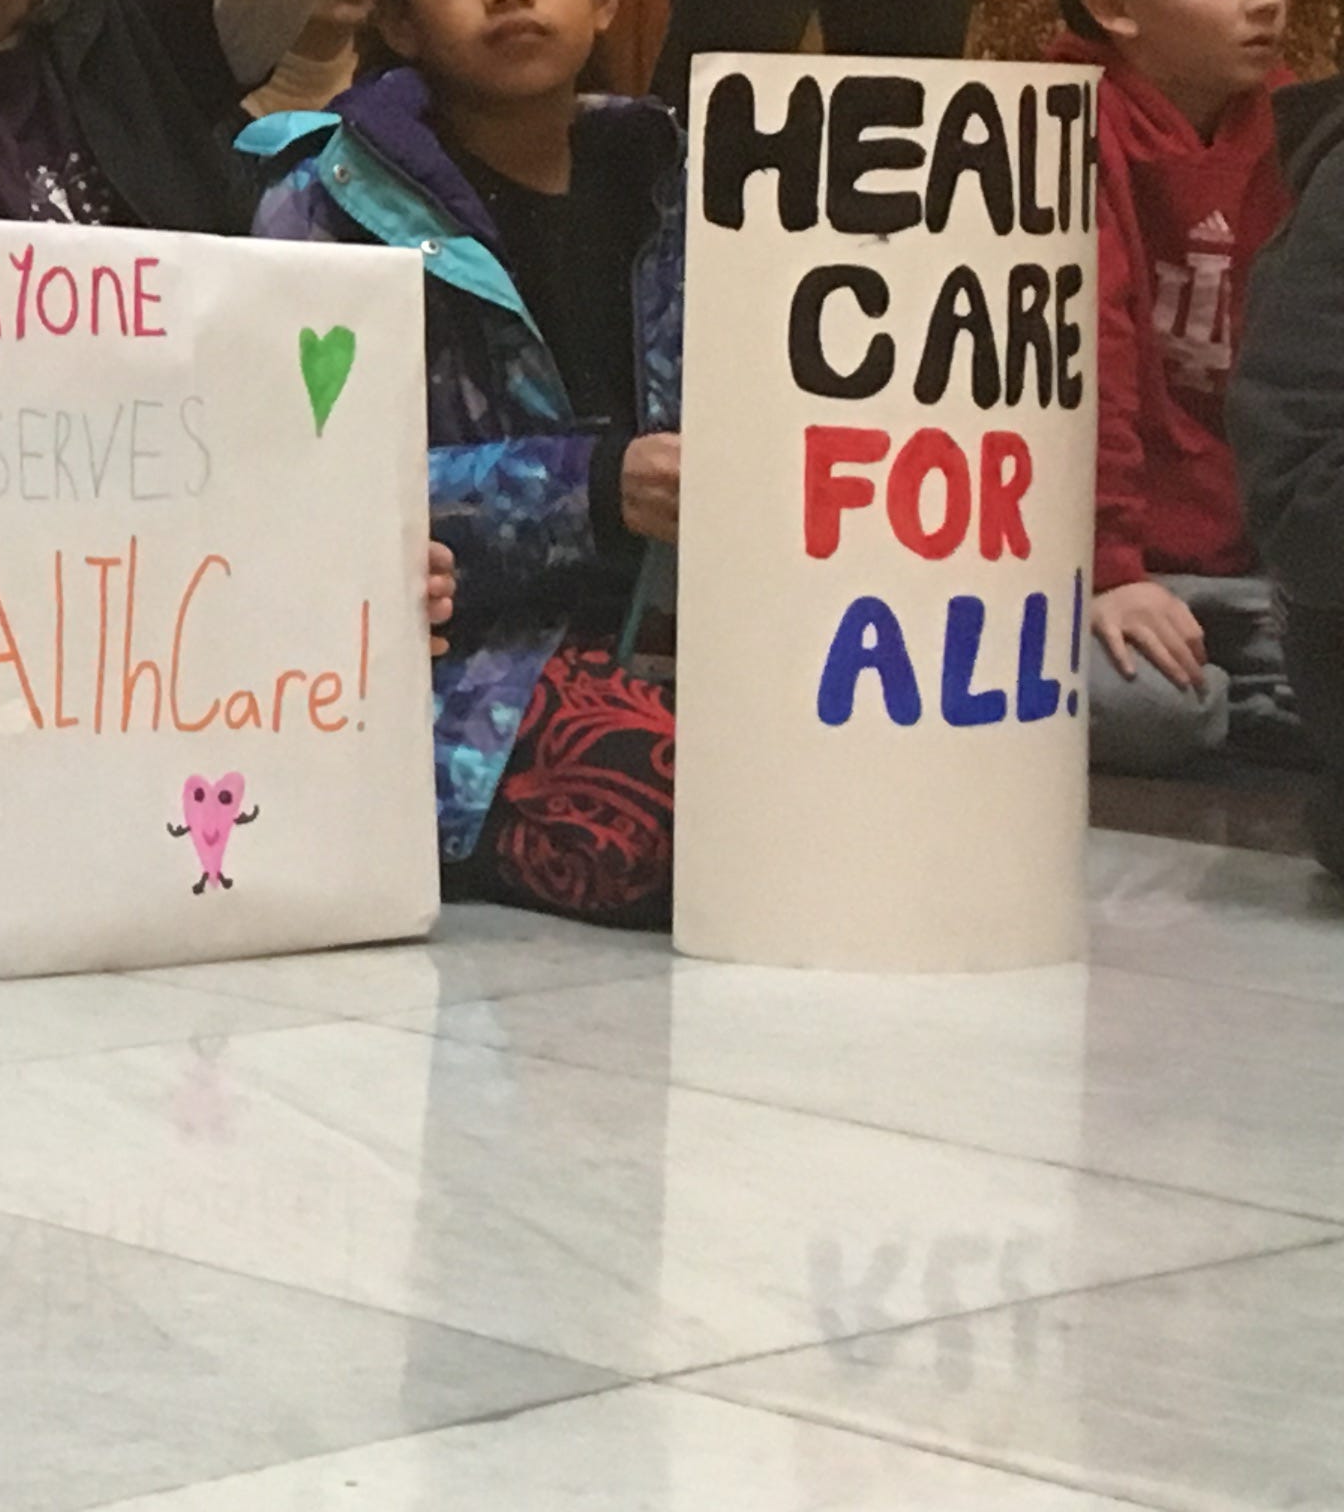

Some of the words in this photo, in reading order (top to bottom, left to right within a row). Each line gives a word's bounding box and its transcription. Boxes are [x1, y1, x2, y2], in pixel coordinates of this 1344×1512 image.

[788, 264, 1084, 409] CARE
[803, 425, 1033, 562] FOR
[816, 567, 1084, 728] ALL!
